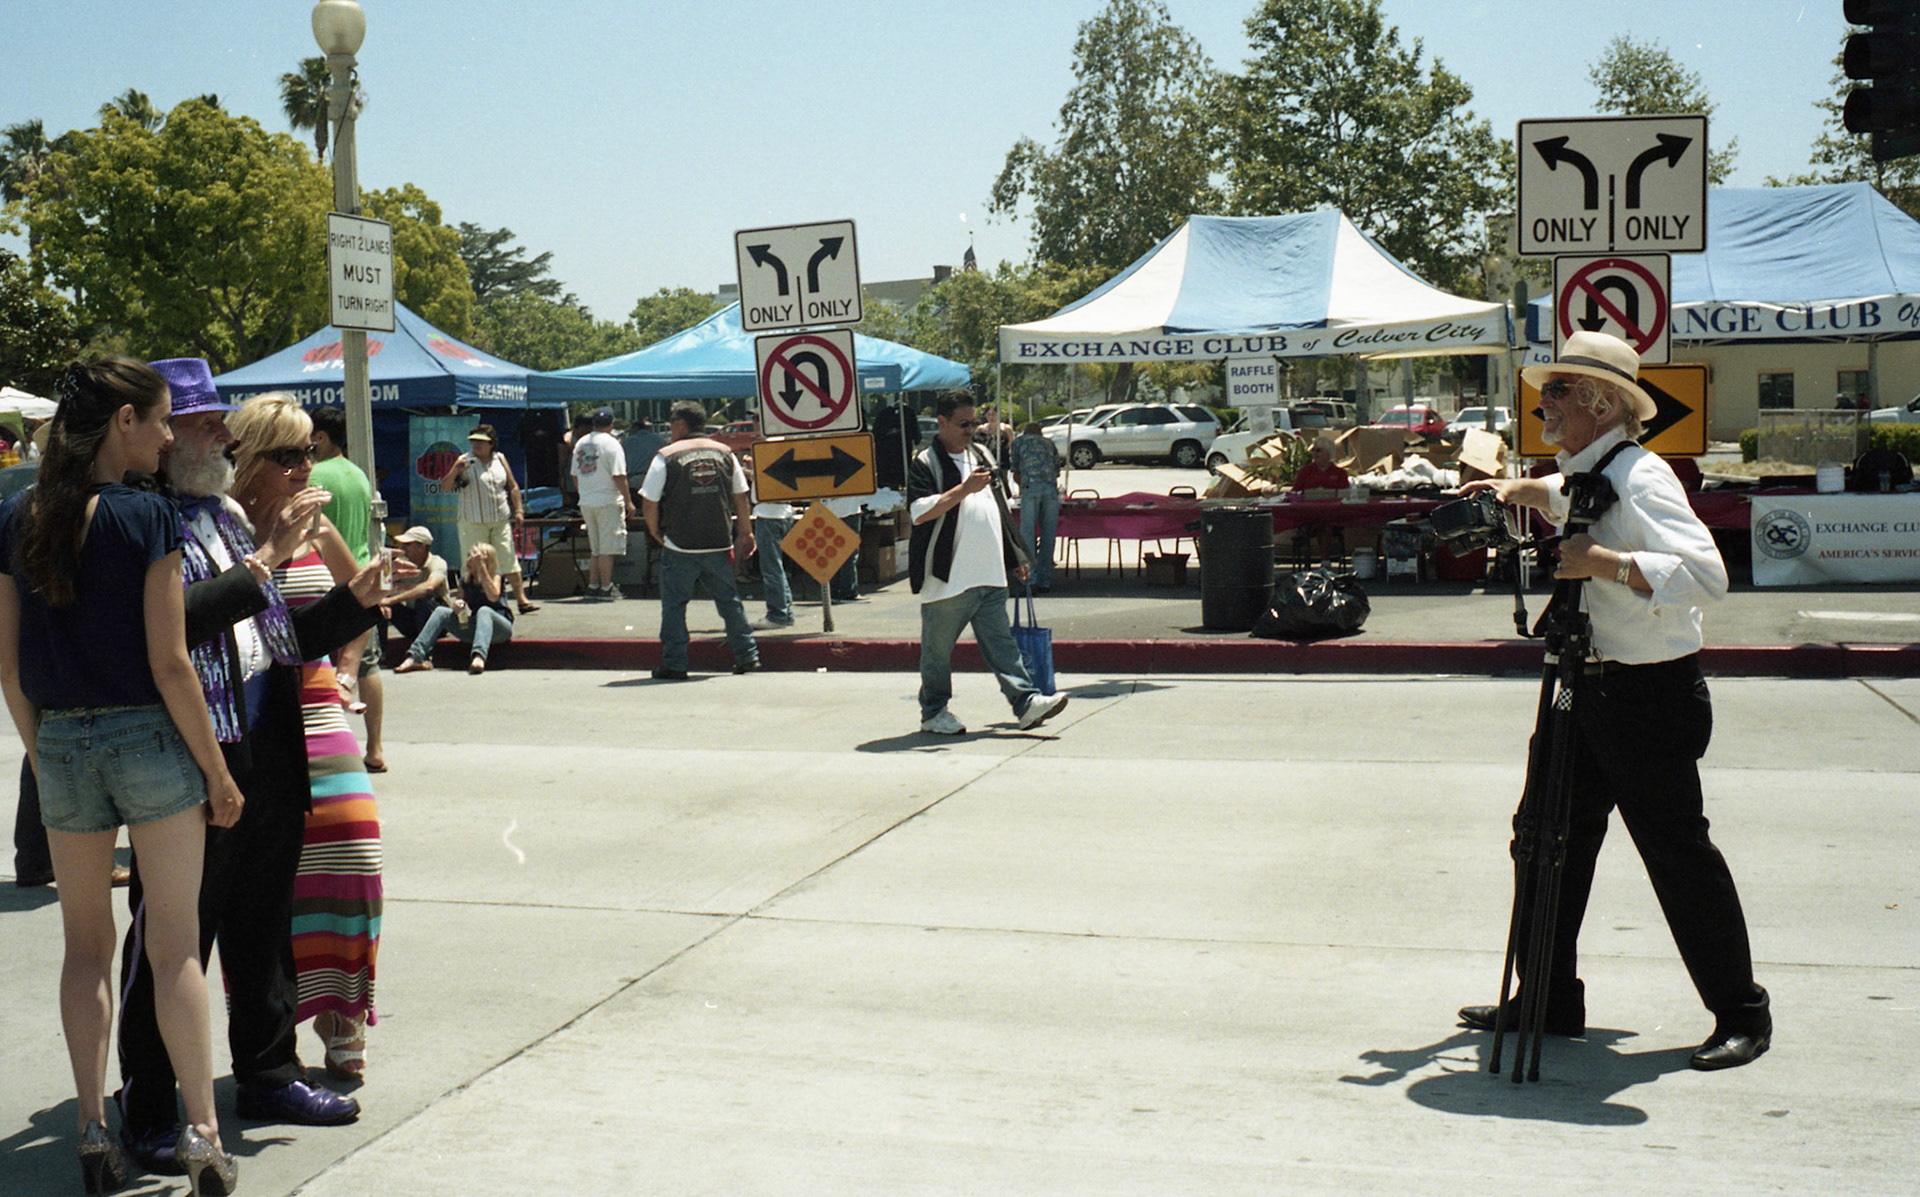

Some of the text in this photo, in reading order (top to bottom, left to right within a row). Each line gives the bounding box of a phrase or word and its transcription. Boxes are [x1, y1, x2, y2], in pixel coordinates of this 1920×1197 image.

[1533, 217, 1597, 243] ONLY
[1625, 215, 1690, 241] ONLY
[331, 233, 390, 255] RIGHT 2 LANES
[343, 263, 382, 284] MUST
[338, 295, 388, 313] TURN RIGHT
[750, 304, 793, 324] ONLY
[808, 298, 852, 319] ONLY
[1776, 301, 1882, 332] CLUB
[1018, 322, 1487, 358] EXCHANGE CLUB of Culver City
[1231, 364, 1275, 378] RAFFLE
[1233, 383, 1274, 395] BOOTH
[1815, 522, 1889, 533] EXCHANGE
[1818, 549, 1880, 559] AMERICA'S
